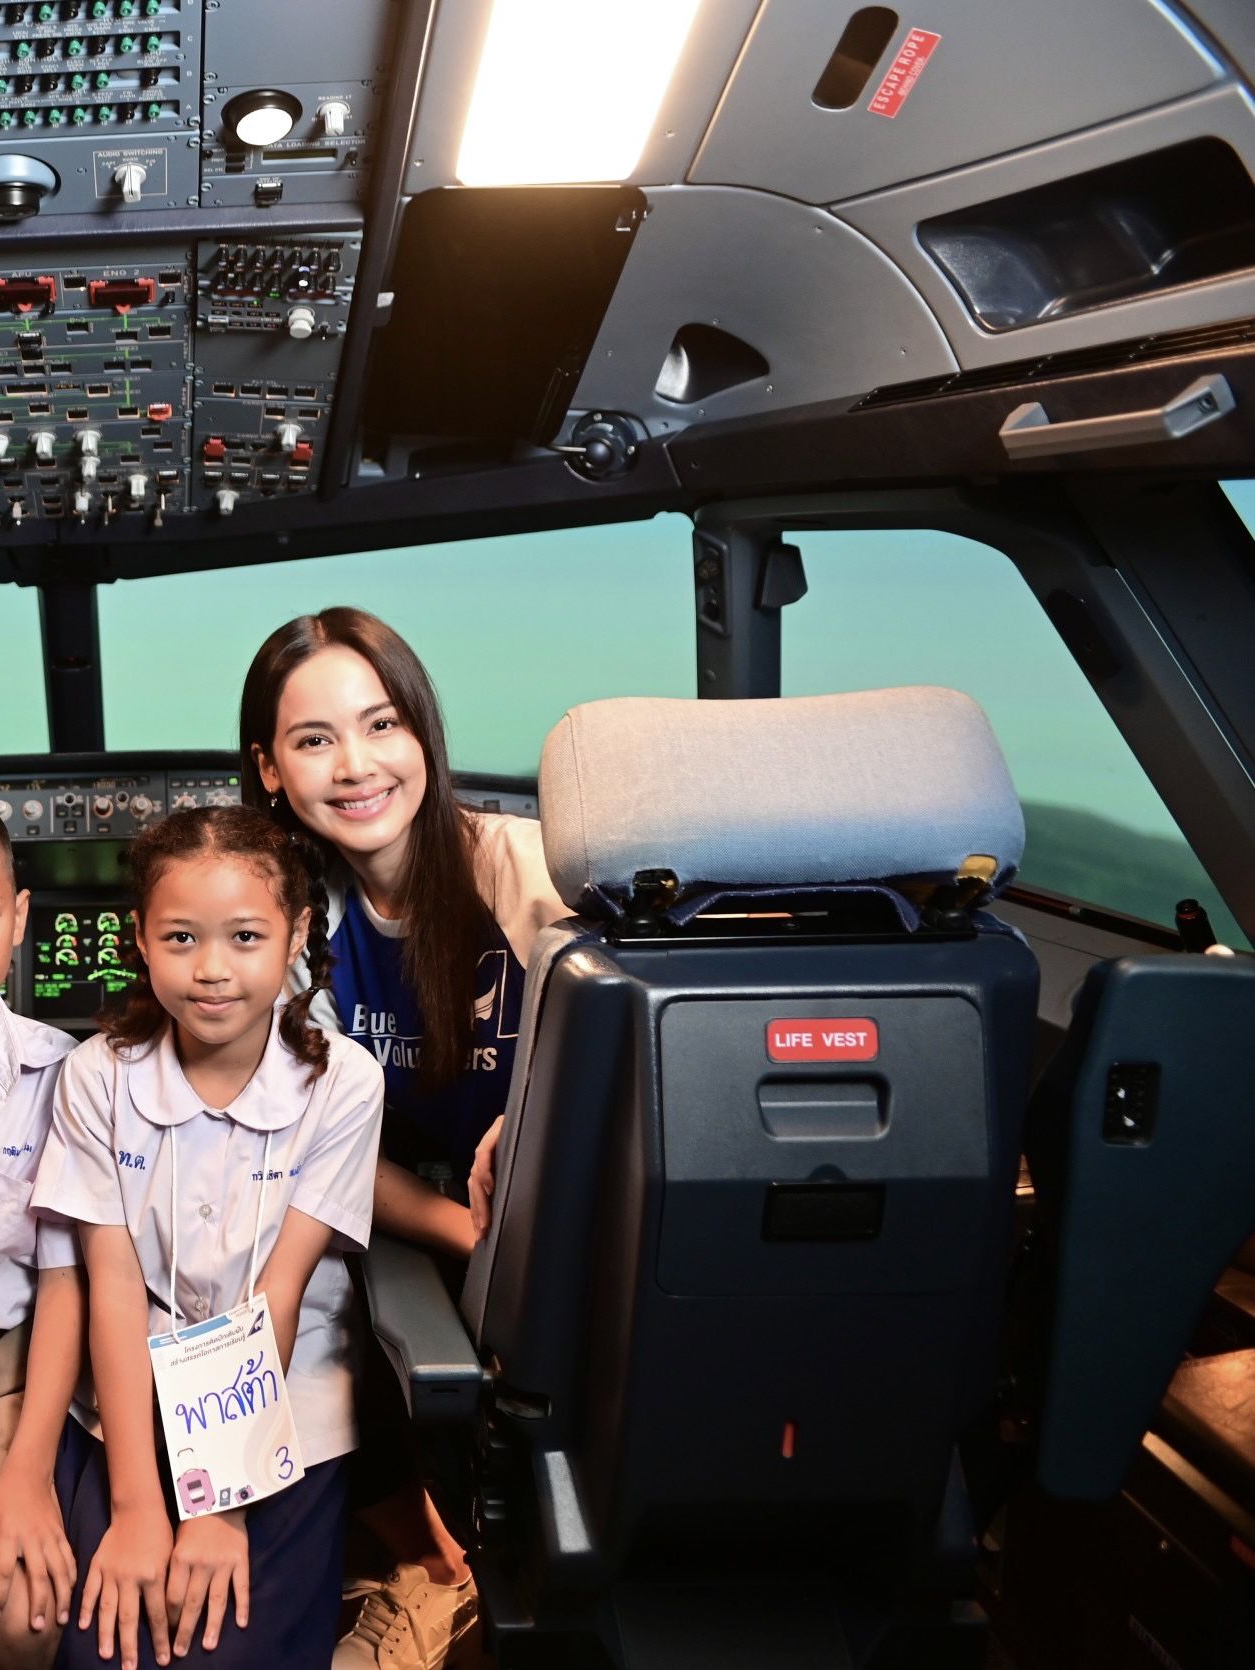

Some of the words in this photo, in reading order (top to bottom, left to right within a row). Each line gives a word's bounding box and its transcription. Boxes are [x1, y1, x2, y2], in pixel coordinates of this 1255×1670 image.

[873, 66, 906, 110] ESCAPE
[898, 34, 925, 65] ROPE
[774, 1033, 813, 1048] LIFE
[821, 1032, 868, 1047] VEST
[175, 1350, 279, 1435] พาสต้า
[275, 1446, 294, 1480] 3
